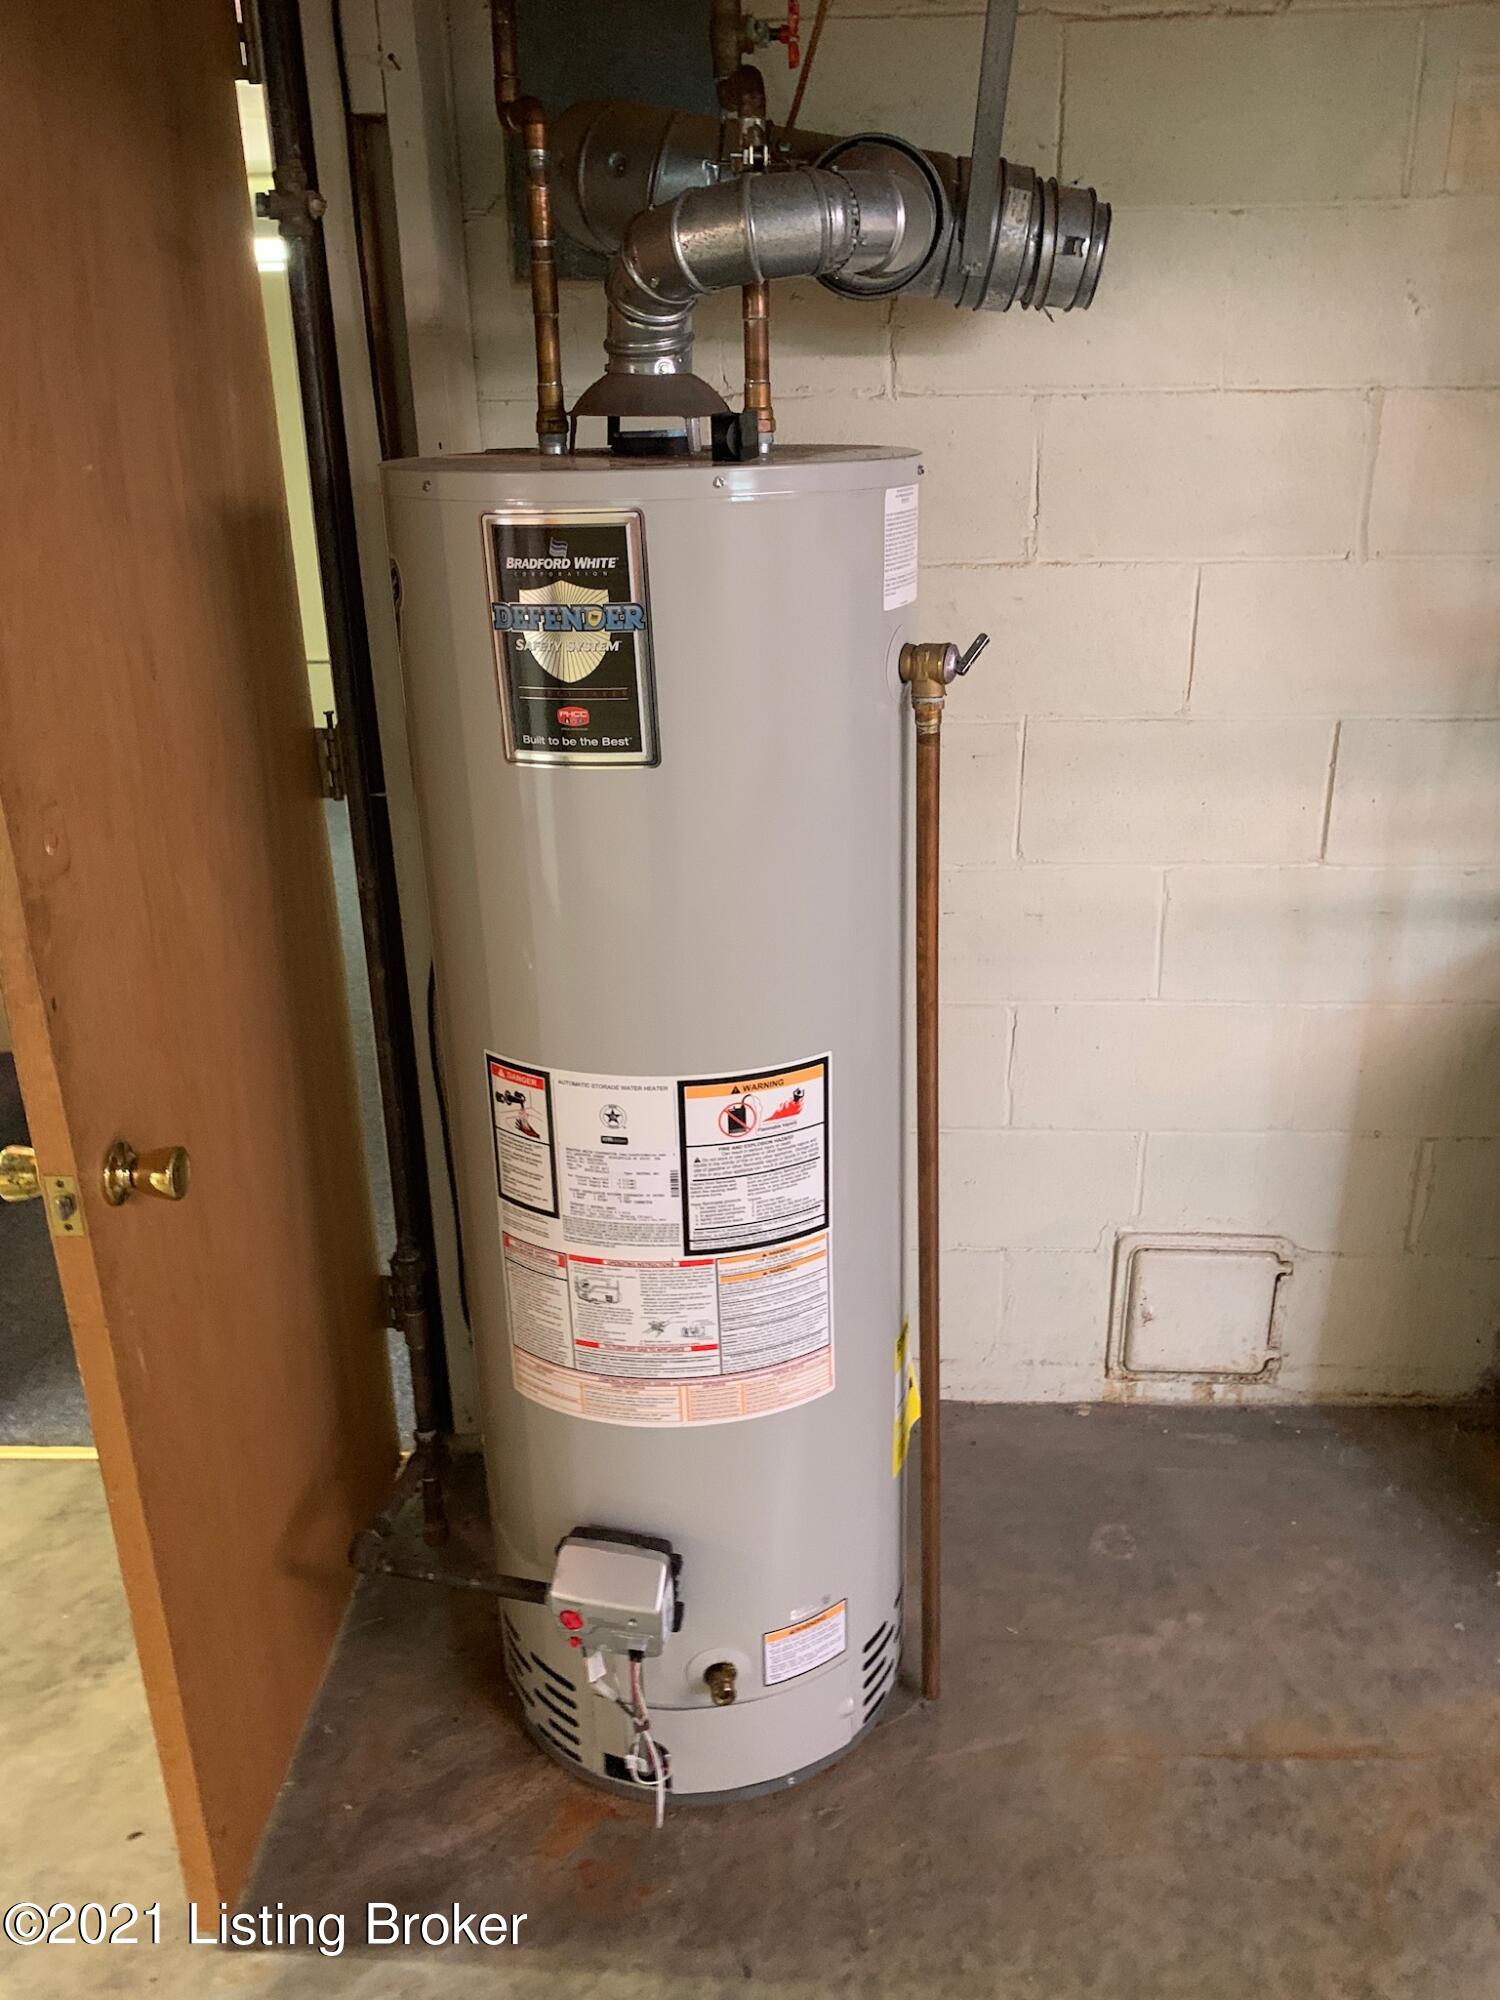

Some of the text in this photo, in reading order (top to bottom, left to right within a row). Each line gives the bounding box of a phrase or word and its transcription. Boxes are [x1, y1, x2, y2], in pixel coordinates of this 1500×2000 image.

[506, 556, 616, 570] BRADFORD WHITE
[493, 603, 645, 631] DEFENDER
[516, 638, 620, 652] SAFETY SYSTEM
[522, 735, 630, 746] Built to be the Best
[504, 1070, 538, 1086] DANGER
[557, 1080, 590, 1089] AUTOMATIC
[591, 1083, 619, 1091] STORAGE
[743, 1079, 785, 1092] WARNING
